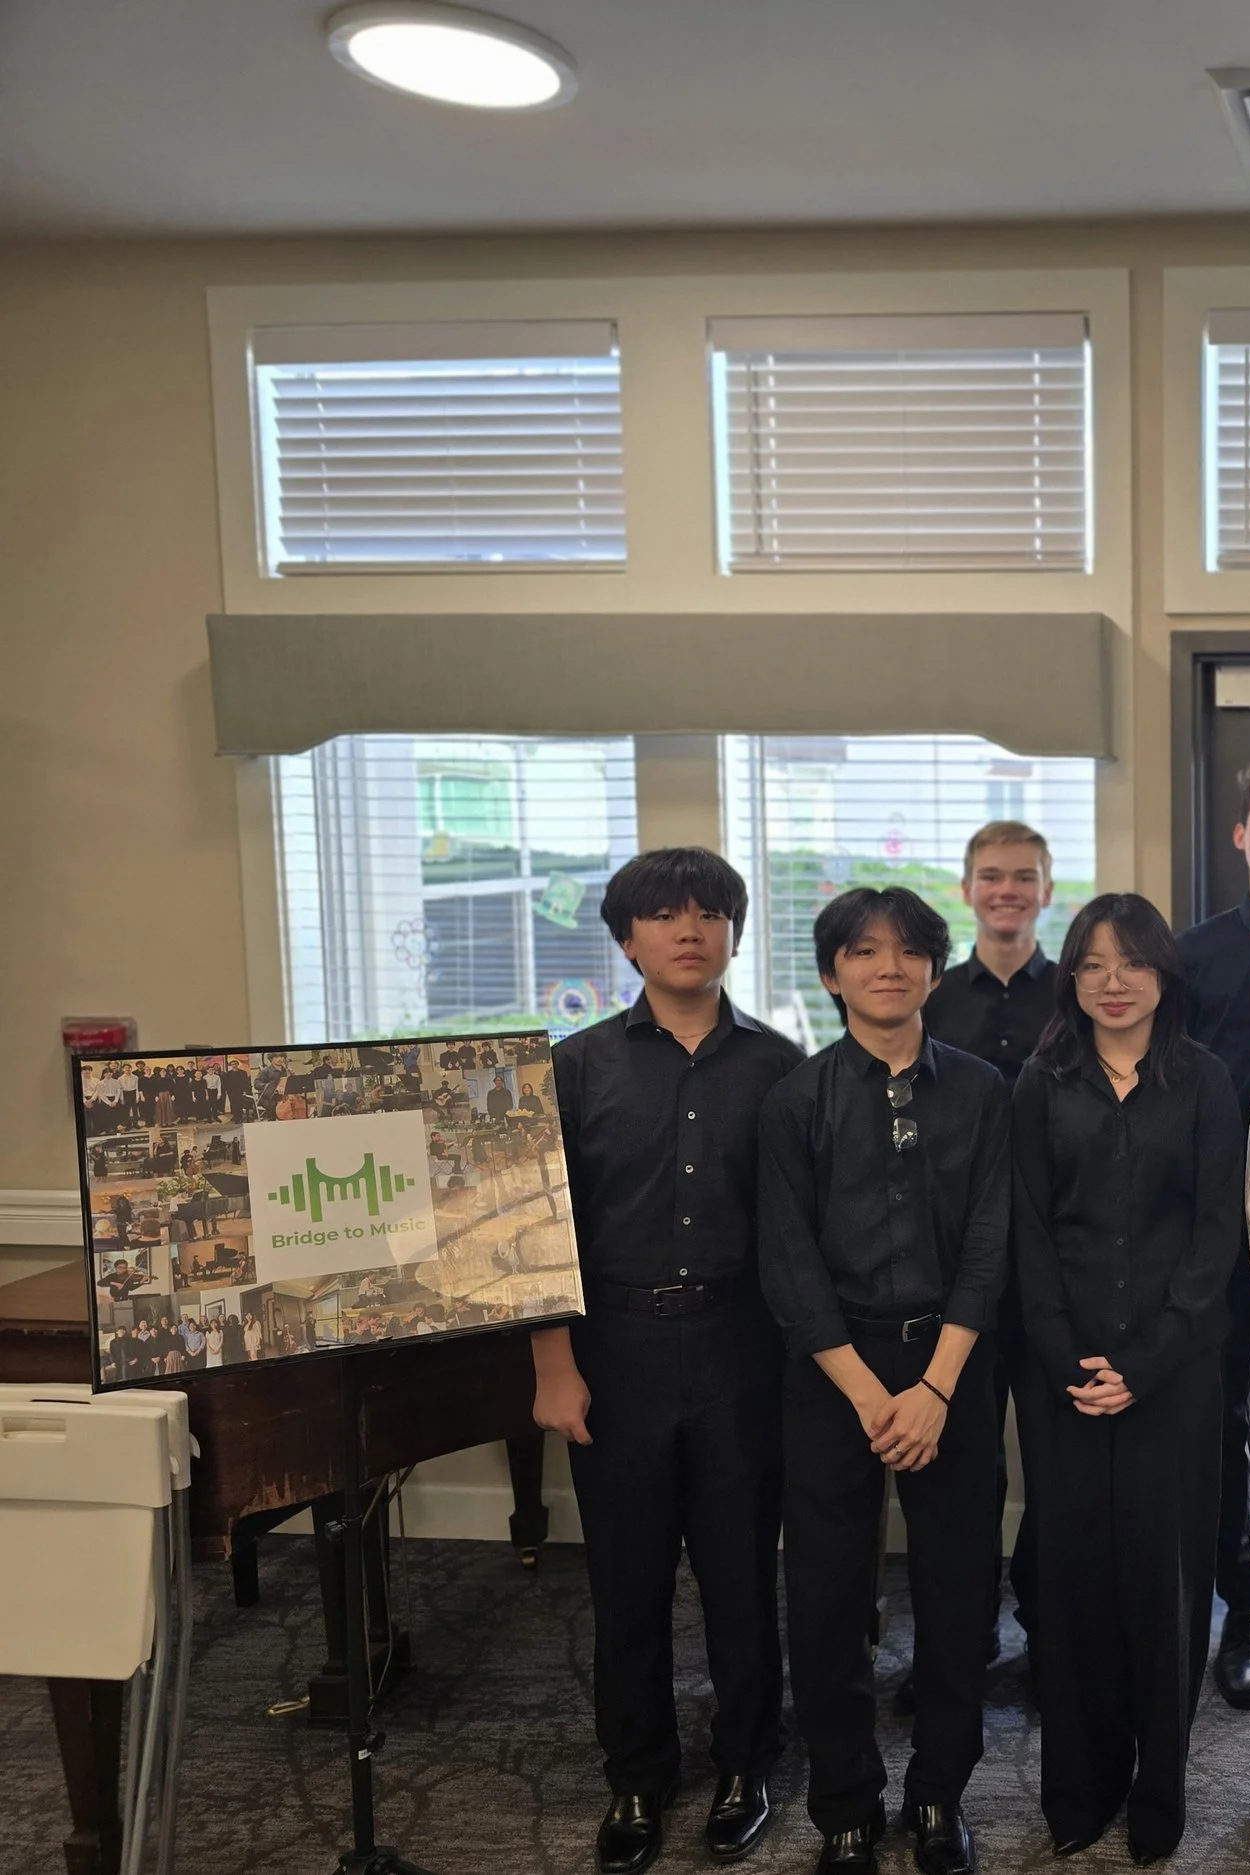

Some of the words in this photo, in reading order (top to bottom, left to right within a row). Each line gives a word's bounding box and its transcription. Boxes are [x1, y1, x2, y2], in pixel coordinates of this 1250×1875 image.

[271, 1230, 338, 1248] Bridge
[344, 1226, 364, 1239] to
[370, 1218, 426, 1236] Music
